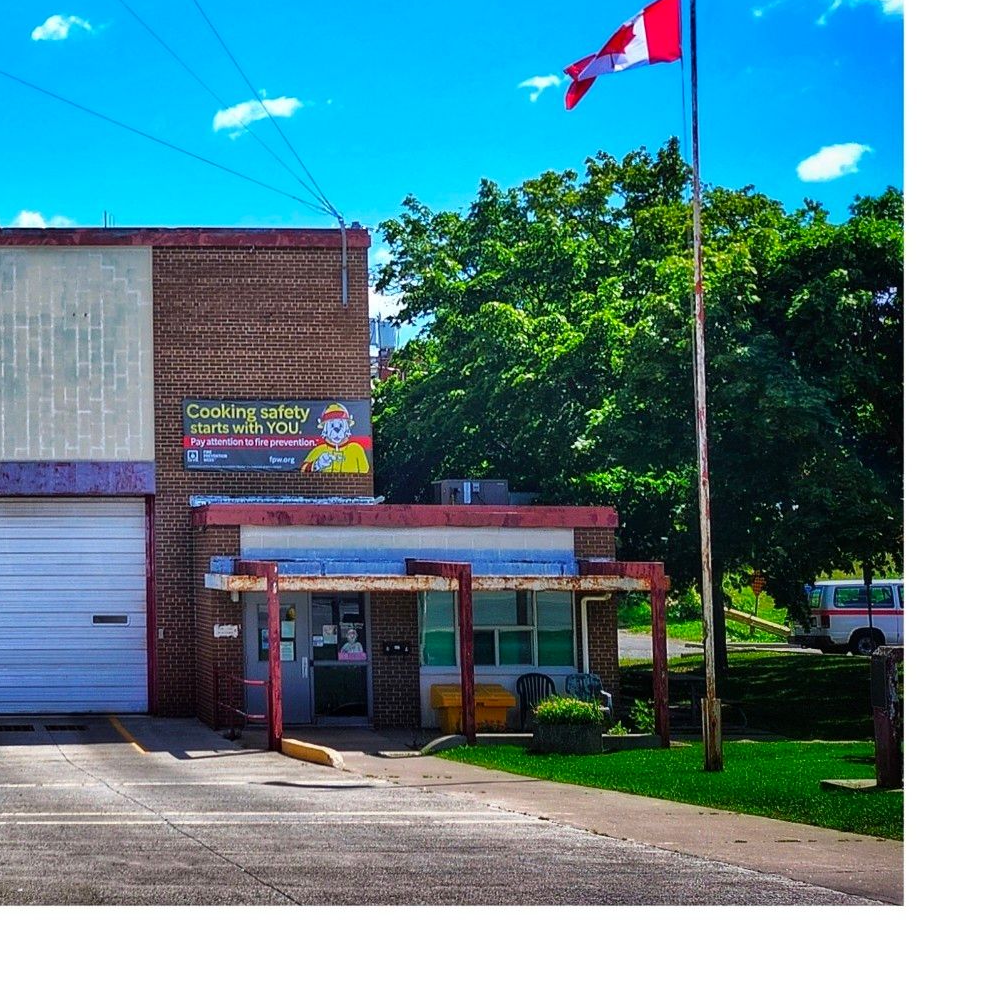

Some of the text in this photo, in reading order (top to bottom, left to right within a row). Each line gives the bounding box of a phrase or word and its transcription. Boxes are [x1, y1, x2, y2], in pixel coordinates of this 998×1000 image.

[186, 403, 310, 422] Cooking safety
[190, 421, 302, 435] starts with YOU.
[190, 436, 317, 448] Pay attention to fire prevention.
[269, 455, 296, 465] fpw.org
